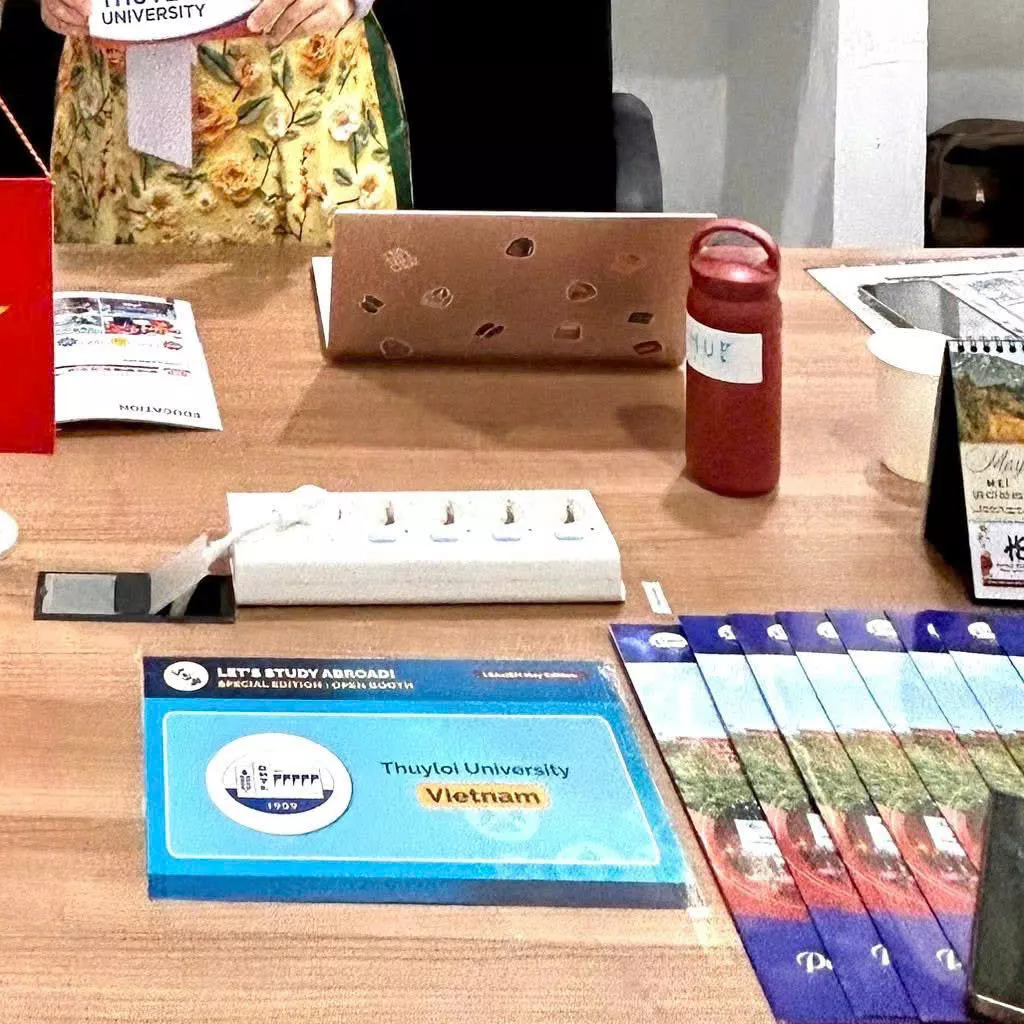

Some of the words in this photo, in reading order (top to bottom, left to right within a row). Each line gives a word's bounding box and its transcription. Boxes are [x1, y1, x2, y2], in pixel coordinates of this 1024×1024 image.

[102, 4, 206, 25] UNIVERSITY
[217, 667, 262, 679] LET'S
[266, 667, 319, 679] STUDY
[322, 668, 396, 680] ABROAD!
[217, 680, 270, 689] SPECIAL
[272, 680, 323, 689] EDITION
[380, 762, 460, 778] Thuyloi
[464, 762, 570, 779] University
[425, 787, 542, 805] Vietnam
